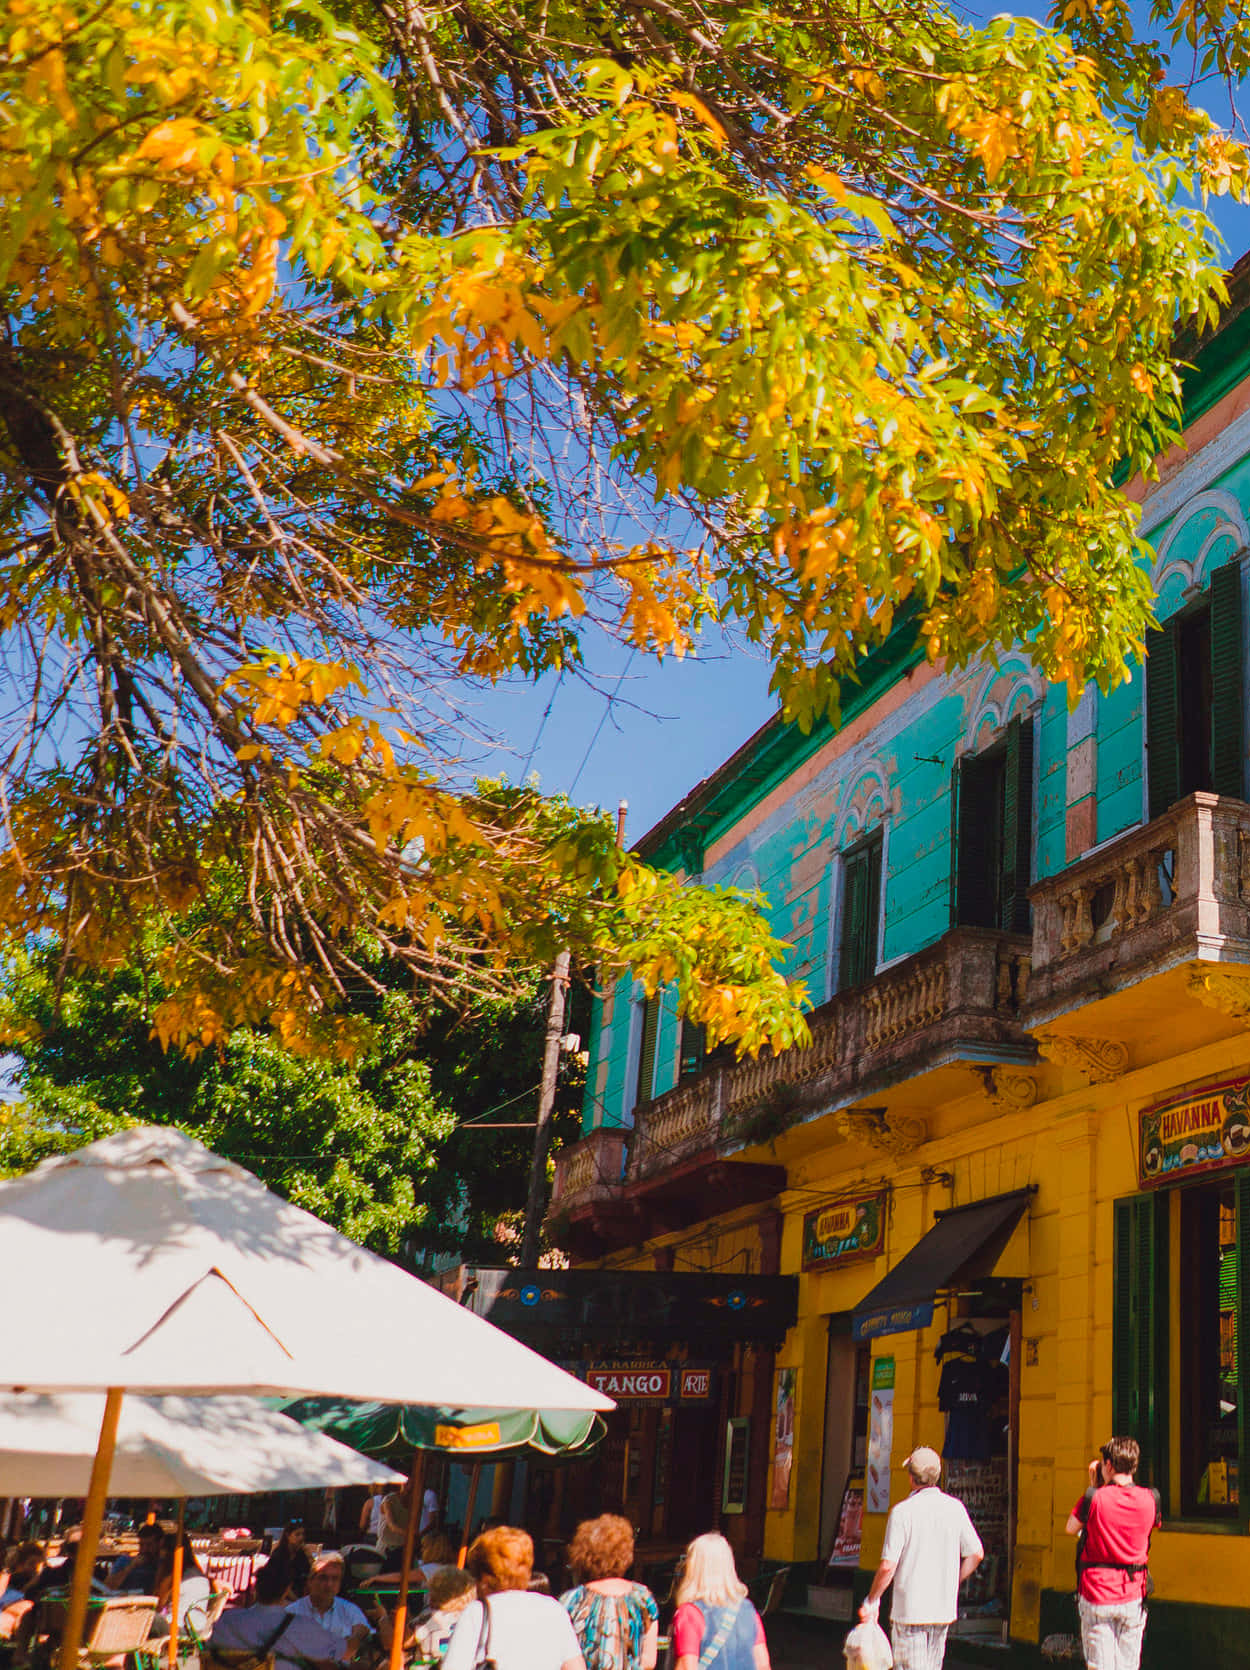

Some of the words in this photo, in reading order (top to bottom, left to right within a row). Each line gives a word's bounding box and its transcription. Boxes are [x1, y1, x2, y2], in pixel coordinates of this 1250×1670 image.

[1162, 1100, 1222, 1139] HAVANNA
[595, 1375, 663, 1393] TANGO
[683, 1375, 708, 1393] ARTE
